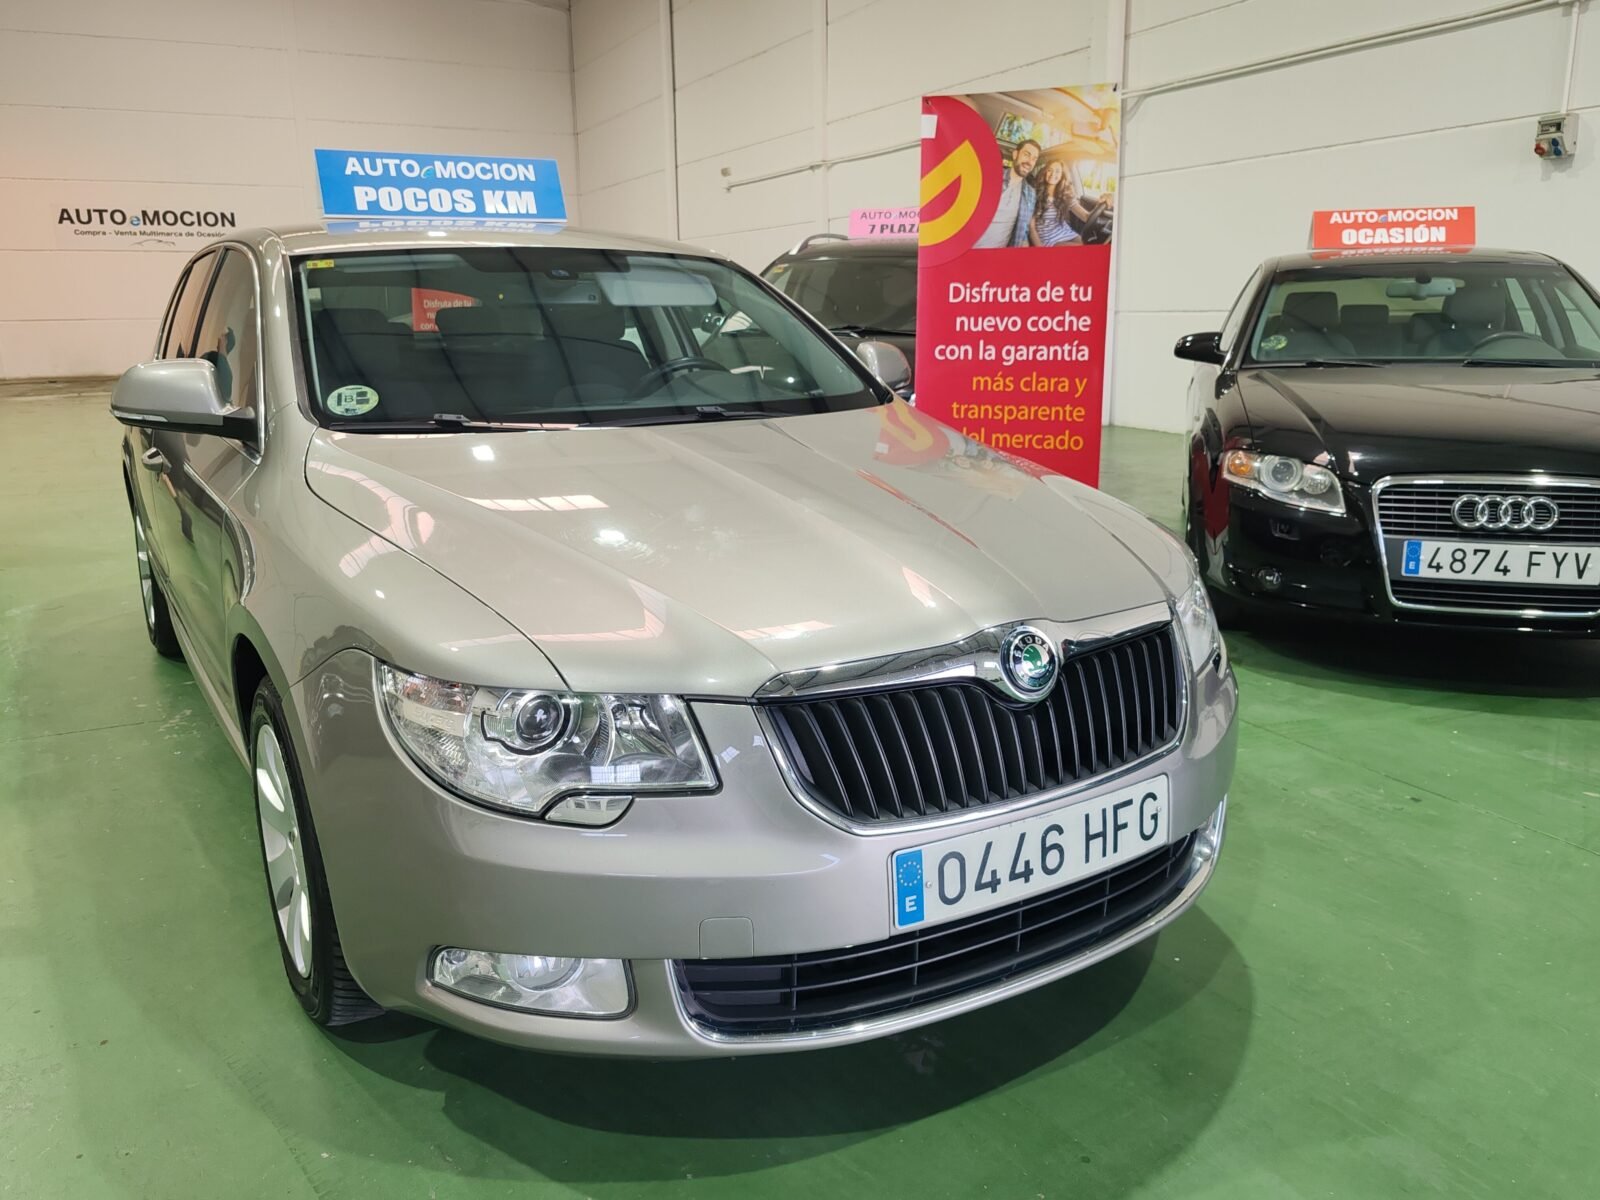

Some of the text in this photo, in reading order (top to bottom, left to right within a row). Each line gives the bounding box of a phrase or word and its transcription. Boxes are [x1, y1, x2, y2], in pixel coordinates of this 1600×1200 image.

[353, 186, 538, 215] POCOS KM
[74, 229, 107, 237] Compra
[114, 229, 138, 237] Venta
[139, 230, 183, 238] Multimarca
[185, 230, 195, 238] de
[868, 224, 876, 234] 7
[1341, 224, 1446, 245] OCASIÓN
[949, 281, 1093, 303] Disfruta de tu
[423, 299, 472, 309] Disfruta de tu
[955, 310, 1092, 332] nuevo coche
[934, 339, 1090, 366] con la garantía
[972, 371, 1088, 398] más clara y
[951, 401, 1086, 424] transparente
[991, 429, 1085, 451] mercado
[1408, 561, 1416, 570] E
[1427, 547, 1591, 580] 4874 FYV
[937, 792, 1158, 906] 0446 HFG
[905, 895, 917, 912] E
